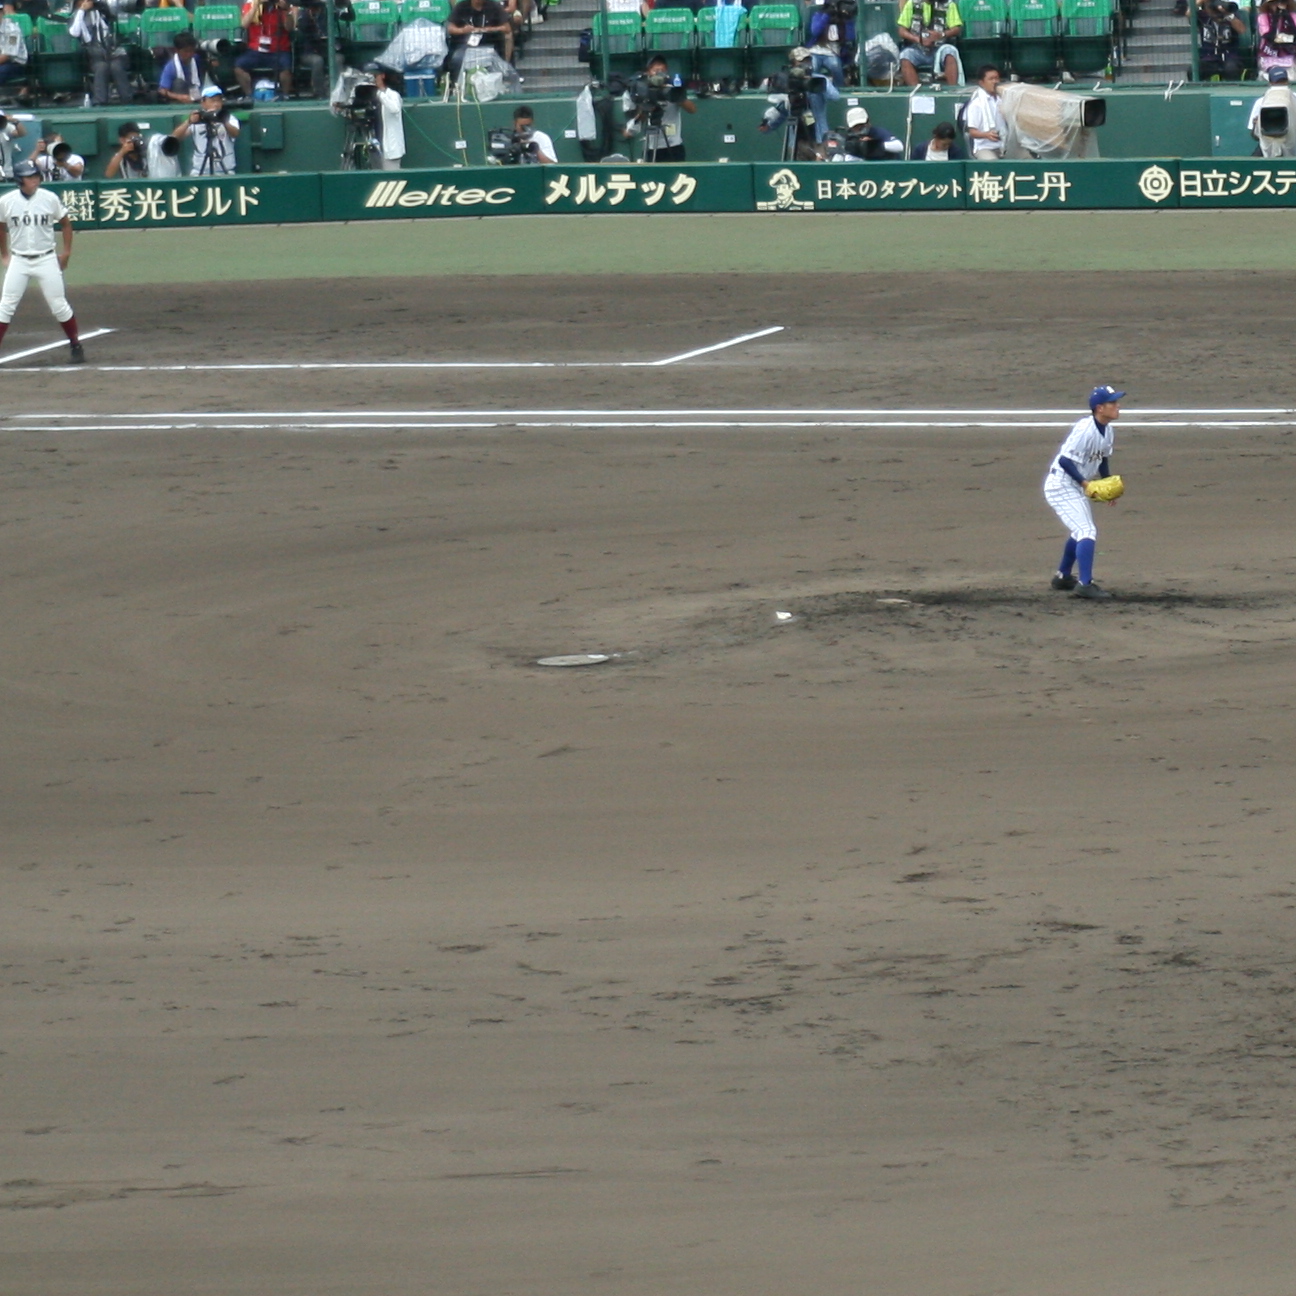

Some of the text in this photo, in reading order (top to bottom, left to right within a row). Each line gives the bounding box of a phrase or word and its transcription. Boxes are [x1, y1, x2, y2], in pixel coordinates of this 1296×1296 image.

[99, 185, 261, 222] 秀光ビルド
[544, 173, 698, 206] メルテック
[816, 171, 1072, 203] 日本のタブレット 梅仁丹
